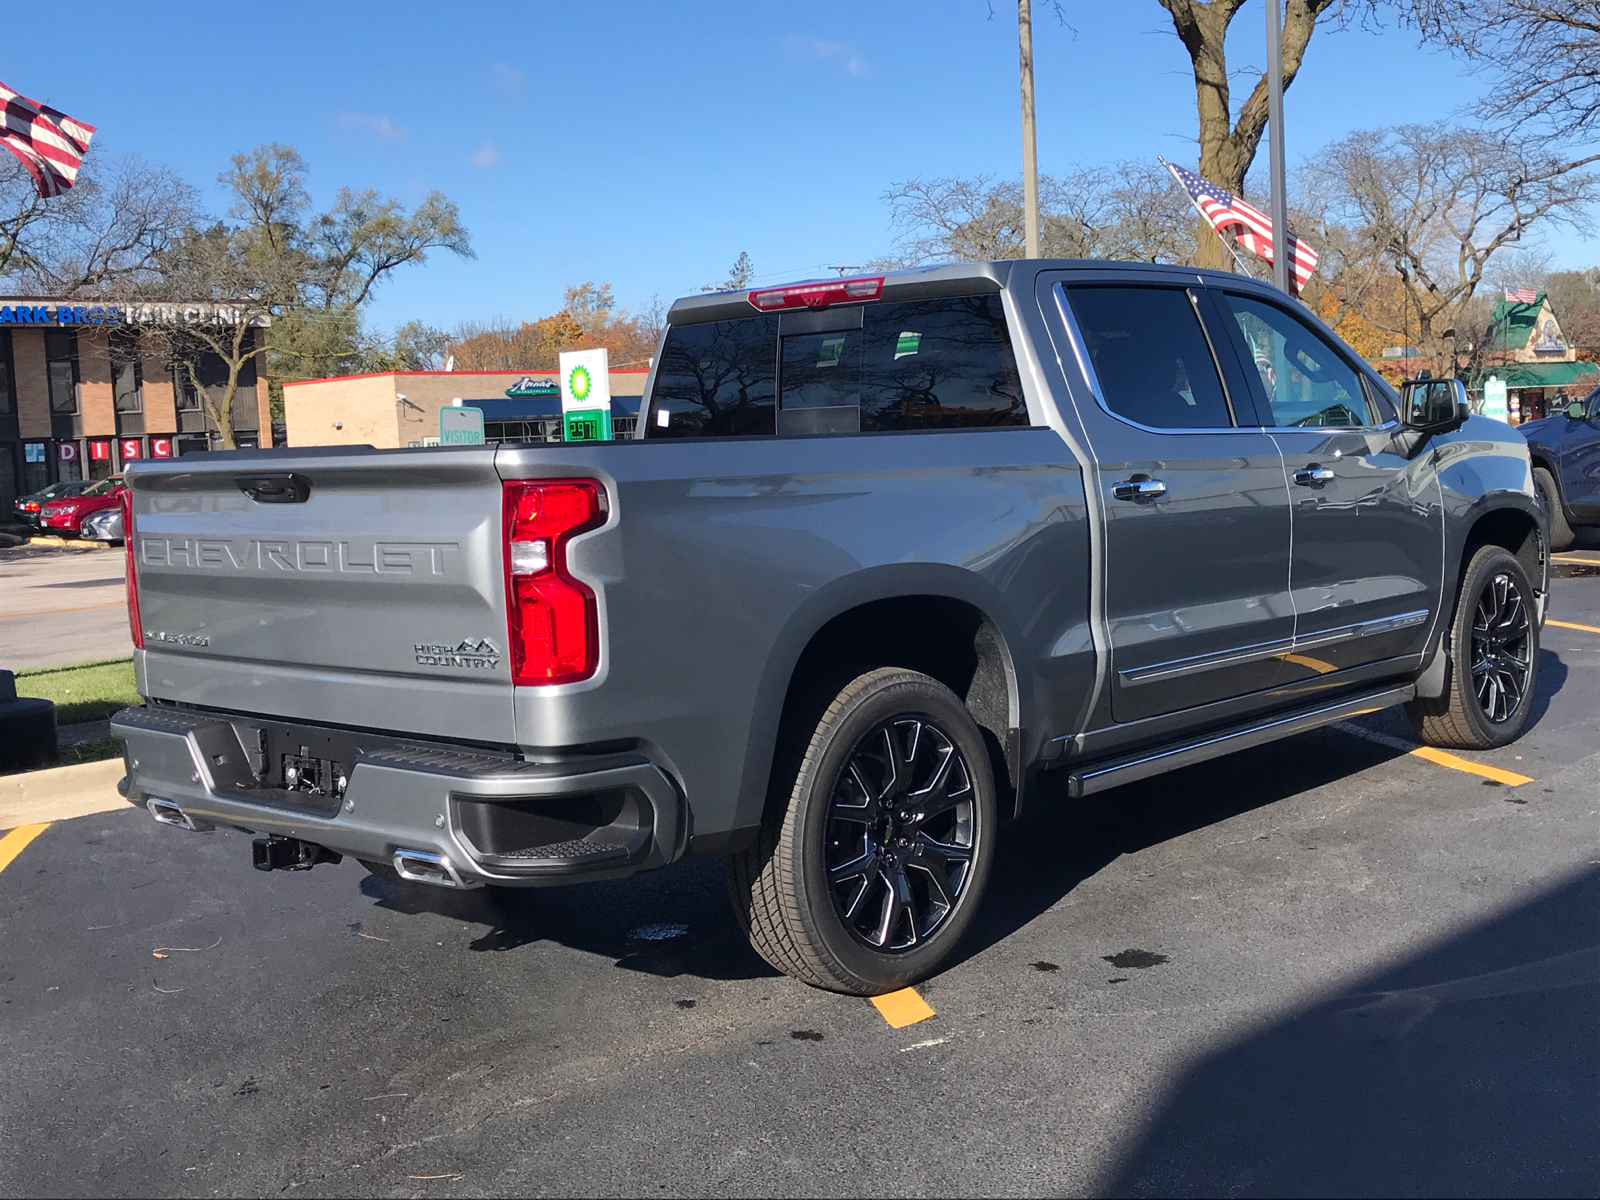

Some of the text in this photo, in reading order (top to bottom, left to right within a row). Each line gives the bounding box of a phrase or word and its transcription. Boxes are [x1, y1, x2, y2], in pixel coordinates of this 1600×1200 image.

[183, 308, 255, 325] CLINI
[444, 430, 480, 443] VISITOR
[141, 537, 460, 576] CHEVROLET
[414, 644, 454, 656] HIGH
[416, 655, 500, 670] COUNTRY
